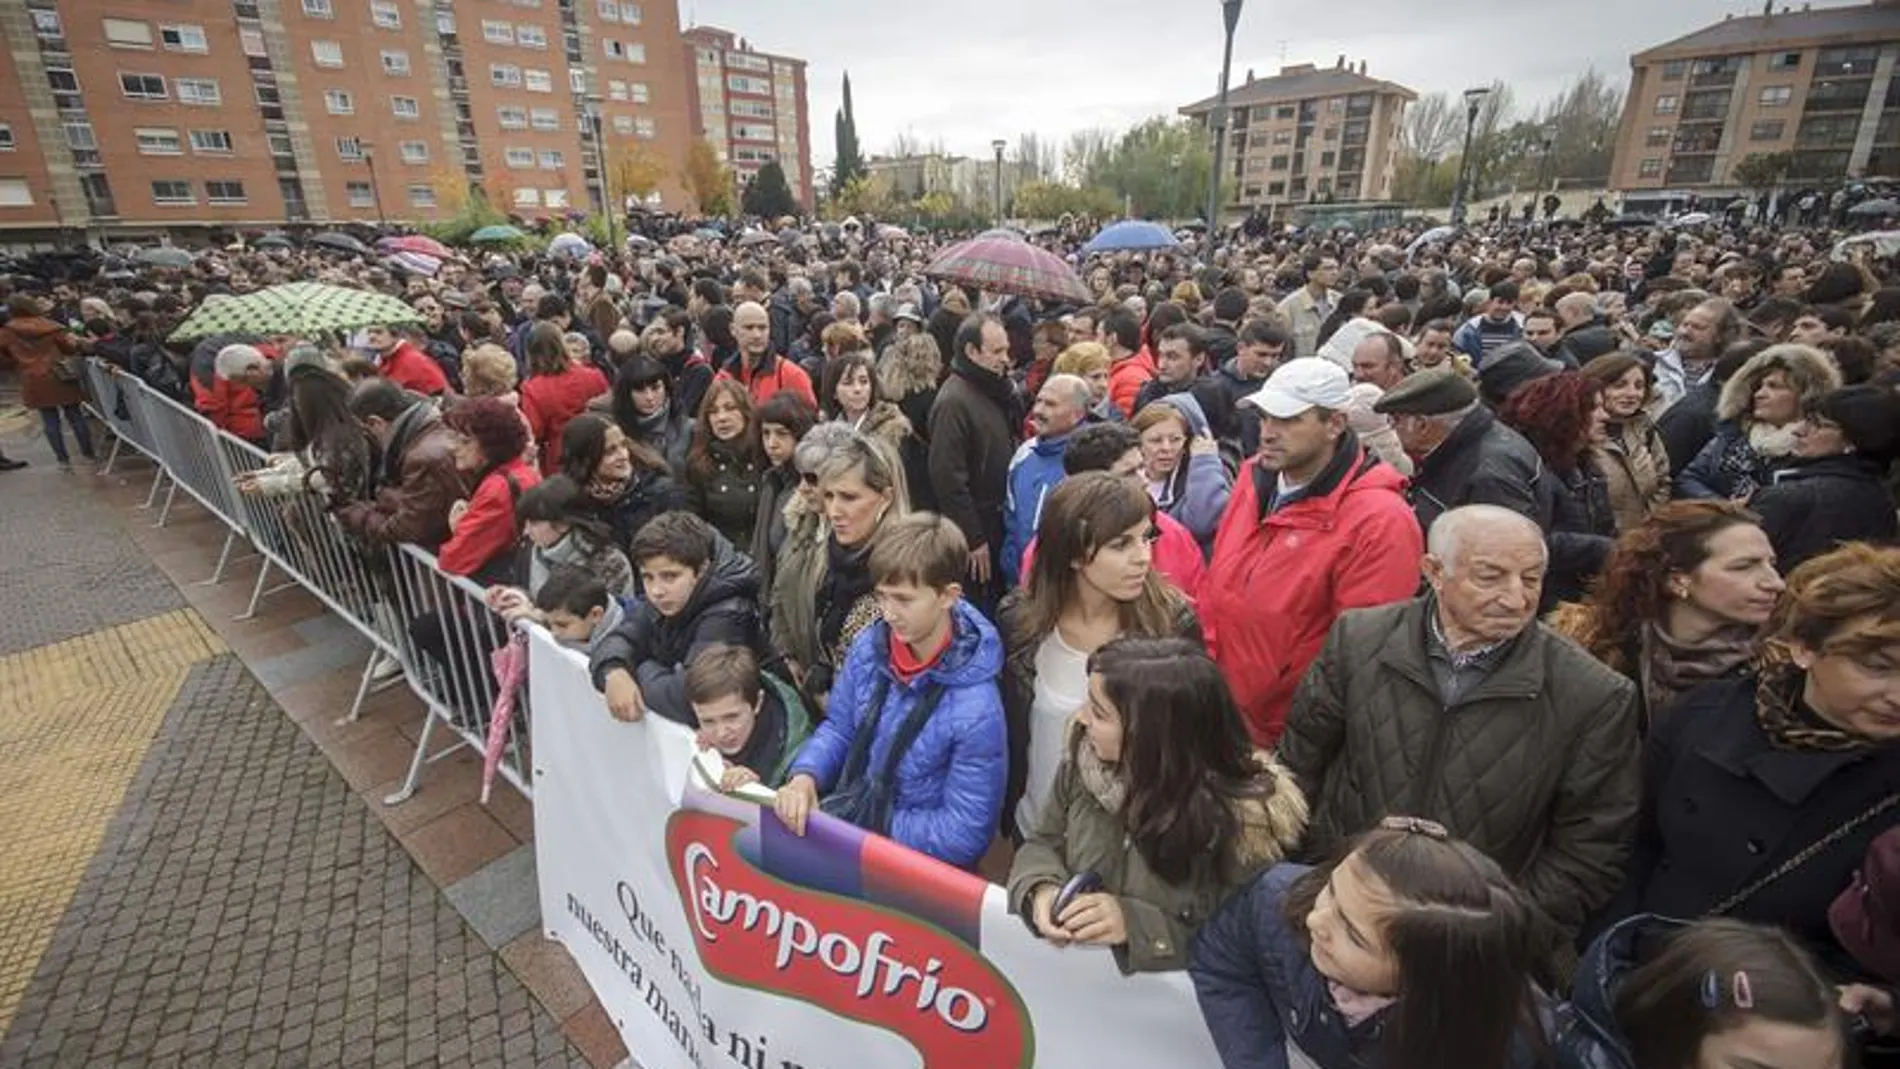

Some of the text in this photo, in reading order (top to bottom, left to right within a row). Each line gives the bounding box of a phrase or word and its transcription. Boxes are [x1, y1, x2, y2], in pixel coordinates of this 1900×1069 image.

[567, 892, 703, 1069] nuestra man
[617, 881, 666, 955] Que
[728, 1032, 766, 1069] ni
[684, 842, 988, 1031] Campofrío
